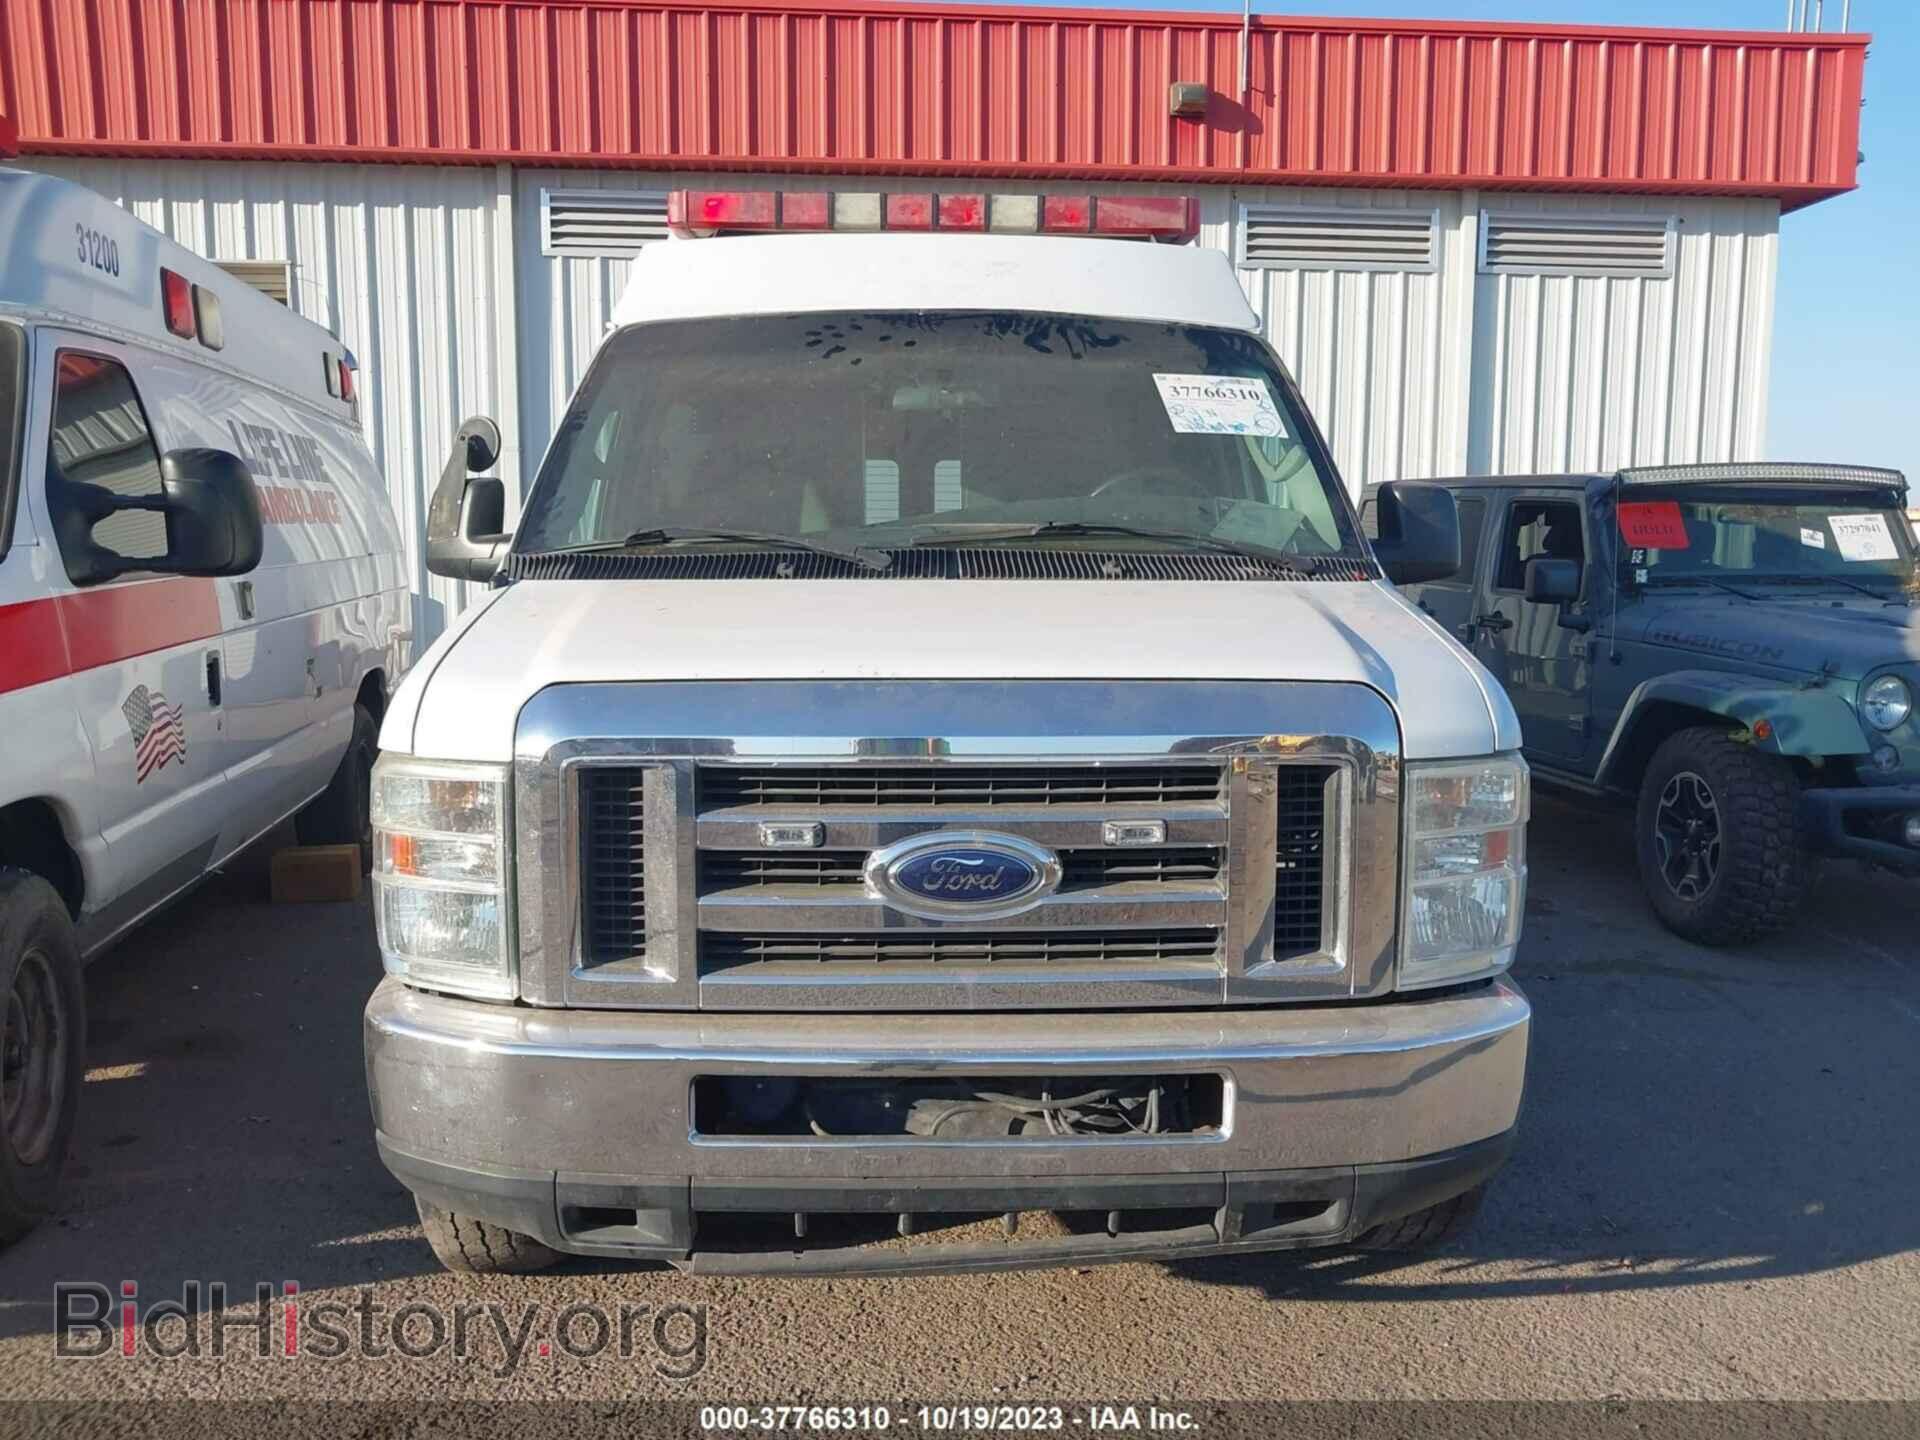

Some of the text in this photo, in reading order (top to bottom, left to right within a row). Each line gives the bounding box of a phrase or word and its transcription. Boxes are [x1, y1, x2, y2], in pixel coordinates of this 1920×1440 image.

[75, 222, 119, 277] 31200
[1168, 384, 1260, 401] 37766310
[922, 857, 1005, 891] Ford
